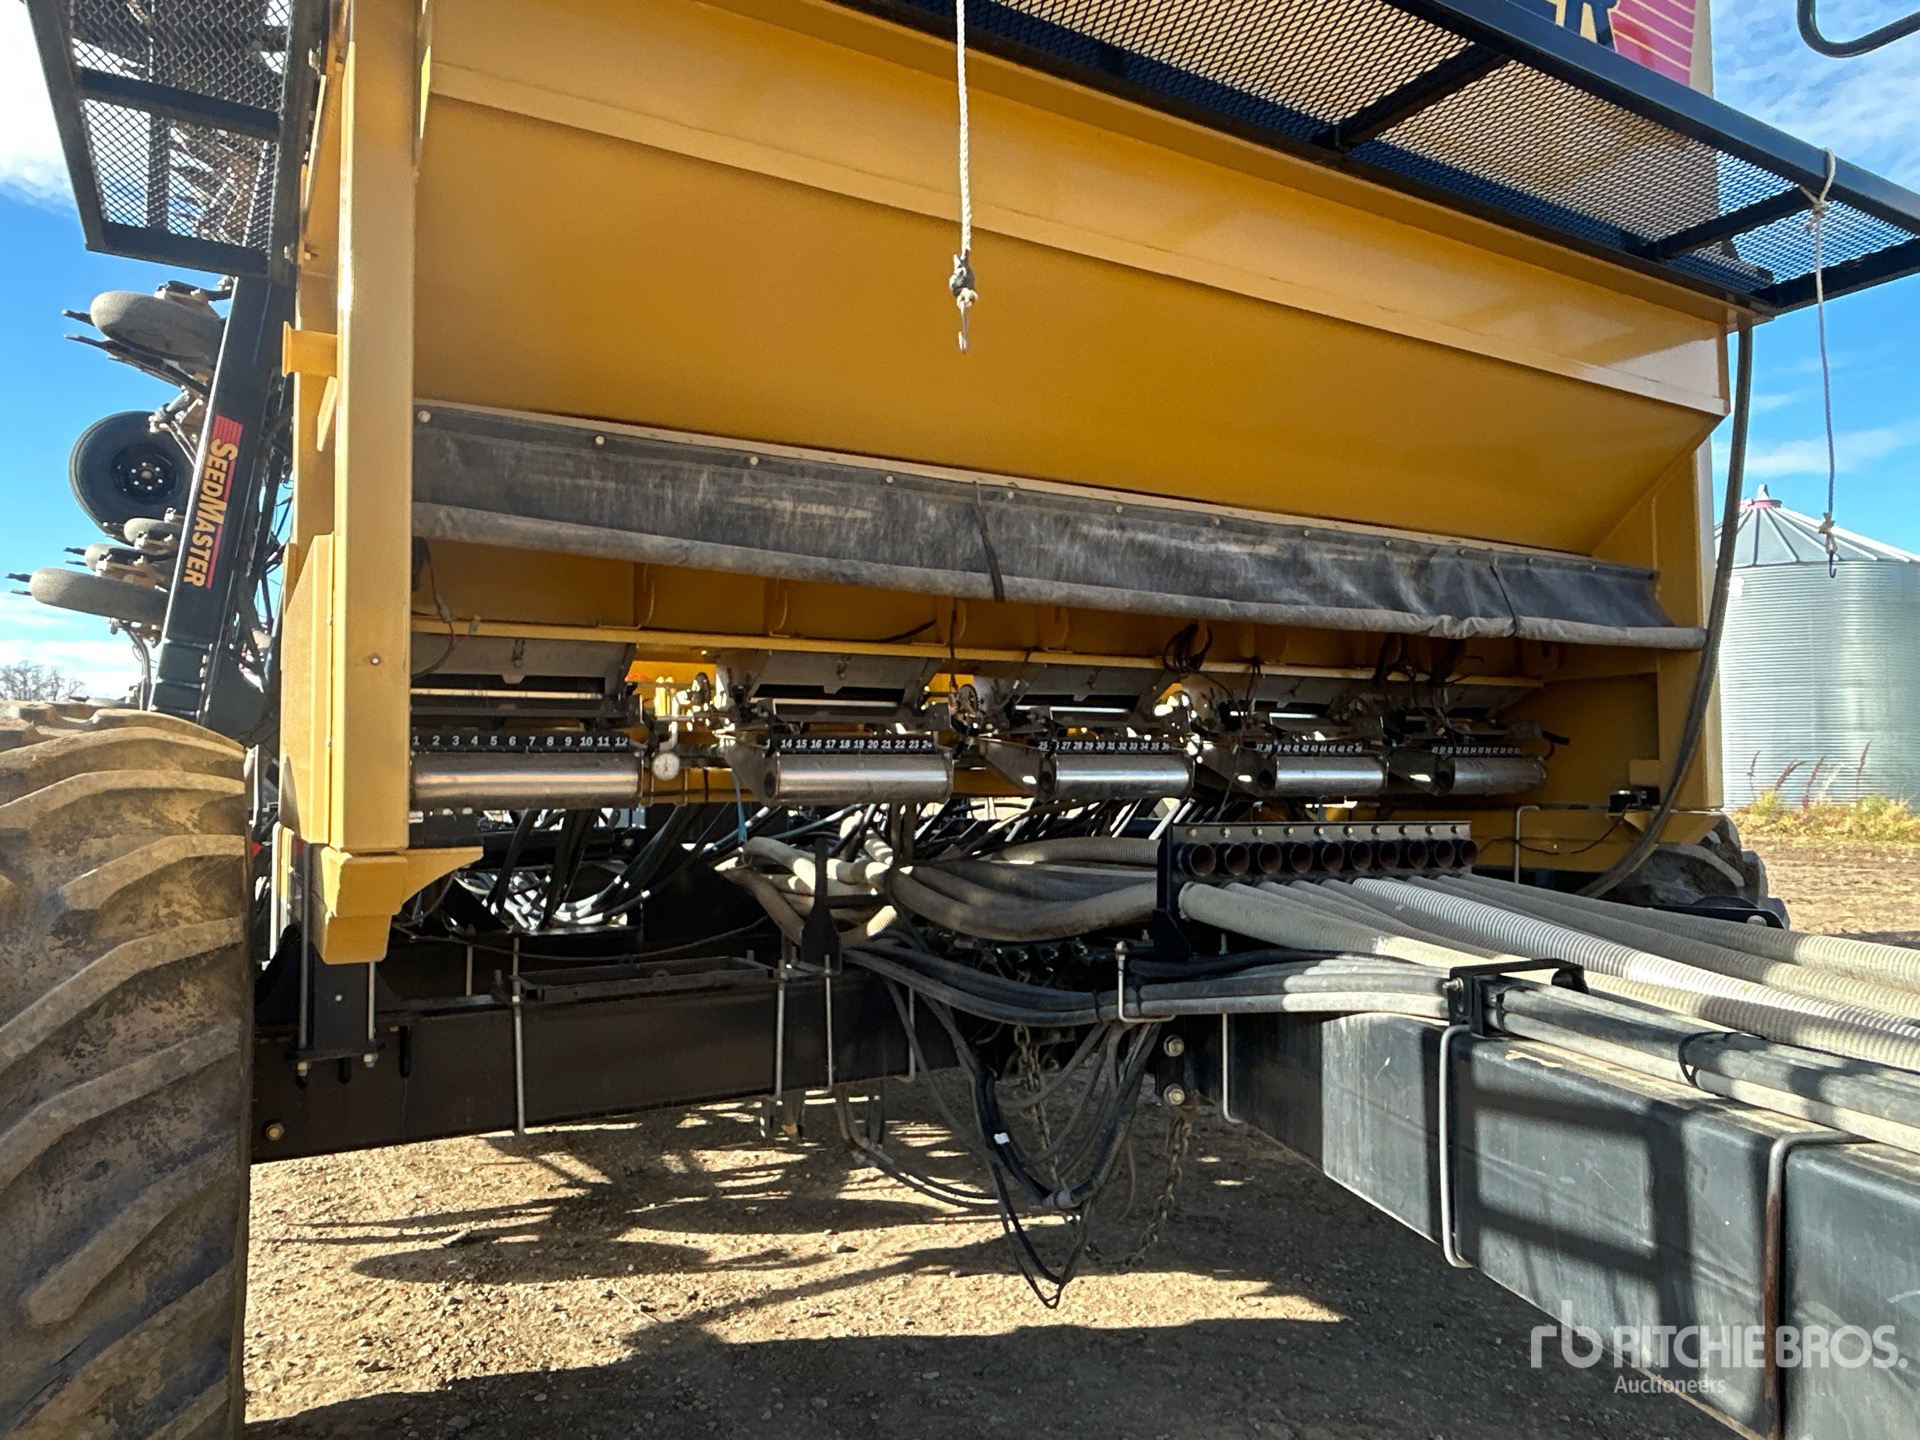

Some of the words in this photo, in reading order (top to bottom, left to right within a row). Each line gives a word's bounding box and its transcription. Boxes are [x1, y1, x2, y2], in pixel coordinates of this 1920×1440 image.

[412, 736, 420, 746] 1
[432, 736, 441, 746] 2
[452, 736, 460, 746] 3
[470, 736, 479, 746] 4
[490, 736, 498, 746] 5
[508, 736, 517, 746] 6
[528, 736, 536, 746] 7
[546, 736, 554, 746] 8
[564, 736, 573, 746] 9
[580, 737, 593, 747] 10
[597, 737, 611, 747] 11
[614, 737, 629, 747] 12
[780, 739, 793, 749] 14
[795, 739, 808, 749] 15
[810, 739, 822, 749] 16
[825, 739, 837, 749] 17
[839, 739, 851, 749] 18
[853, 739, 865, 749] 19
[867, 739, 879, 749] 20
[881, 739, 892, 749] 21
[894, 739, 906, 749] 22
[908, 739, 920, 749] 23
